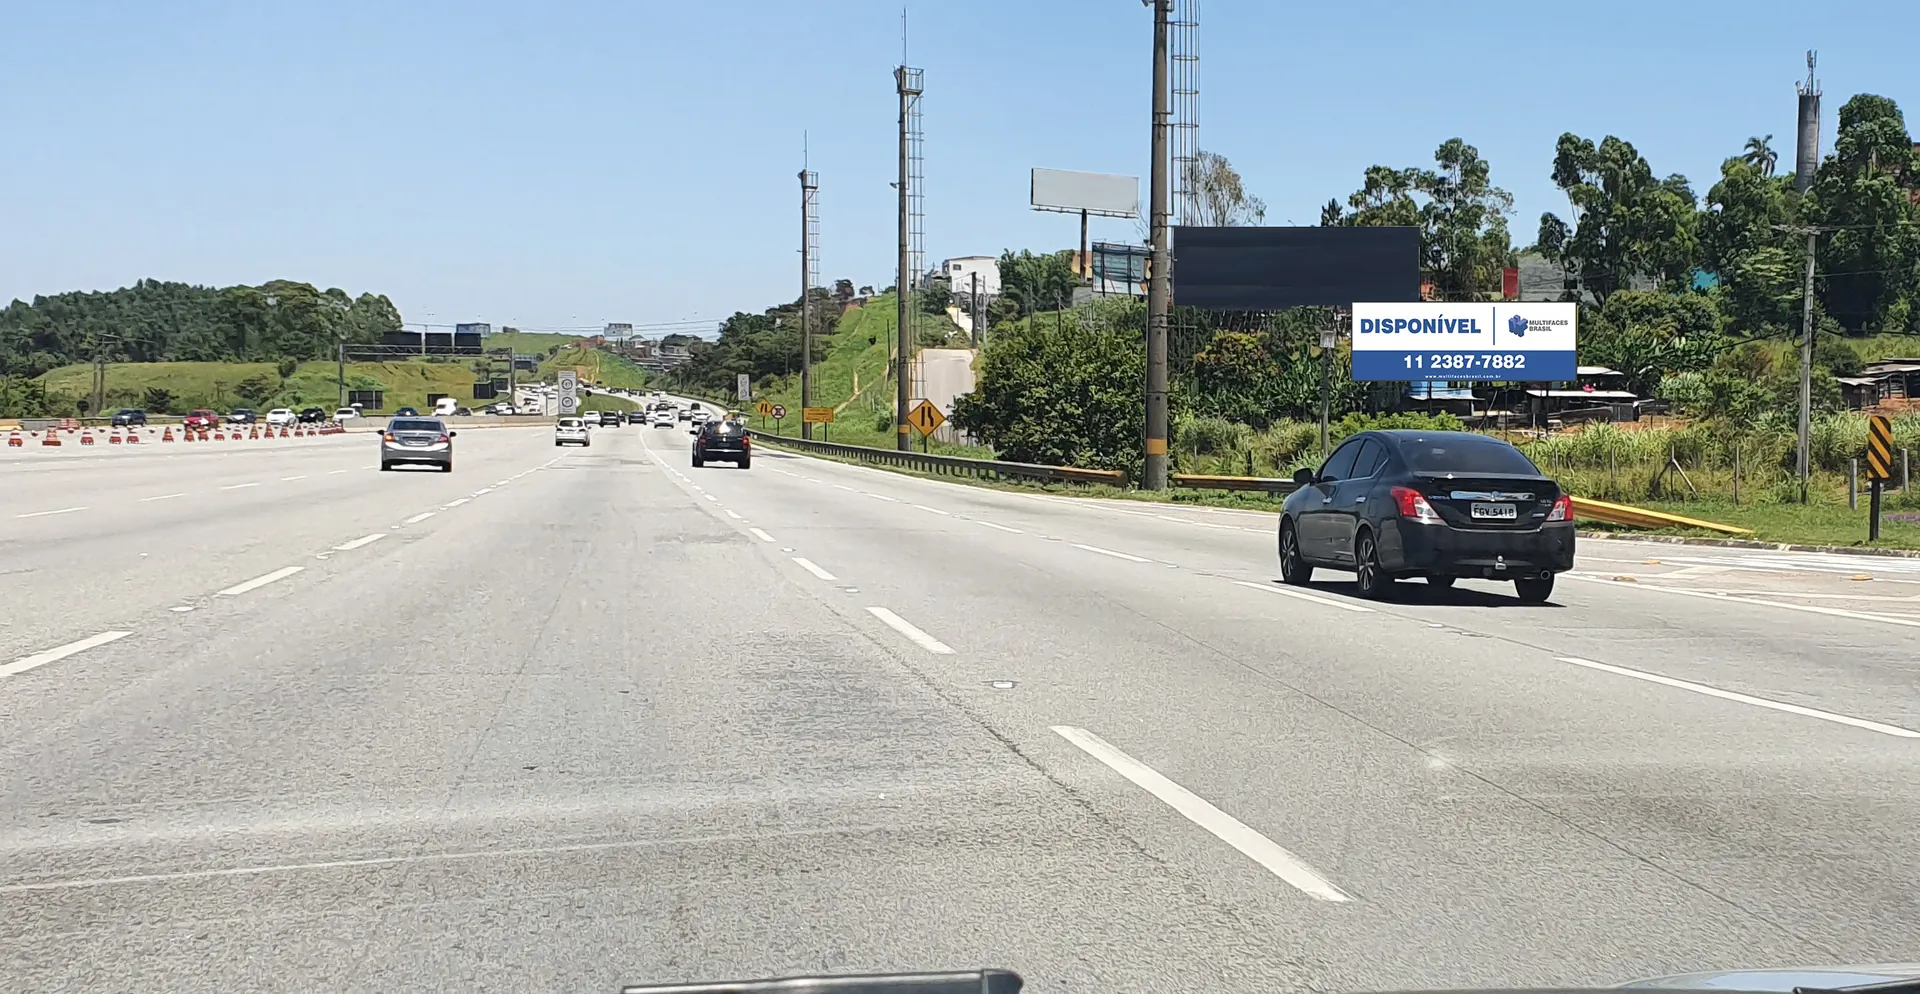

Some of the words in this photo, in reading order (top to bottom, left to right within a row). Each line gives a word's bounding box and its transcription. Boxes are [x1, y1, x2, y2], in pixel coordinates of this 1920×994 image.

[1360, 314, 1481, 334] DISPONÍVEL
[1403, 354, 1423, 369] 11
[1430, 354, 1526, 369] 2387-7882
